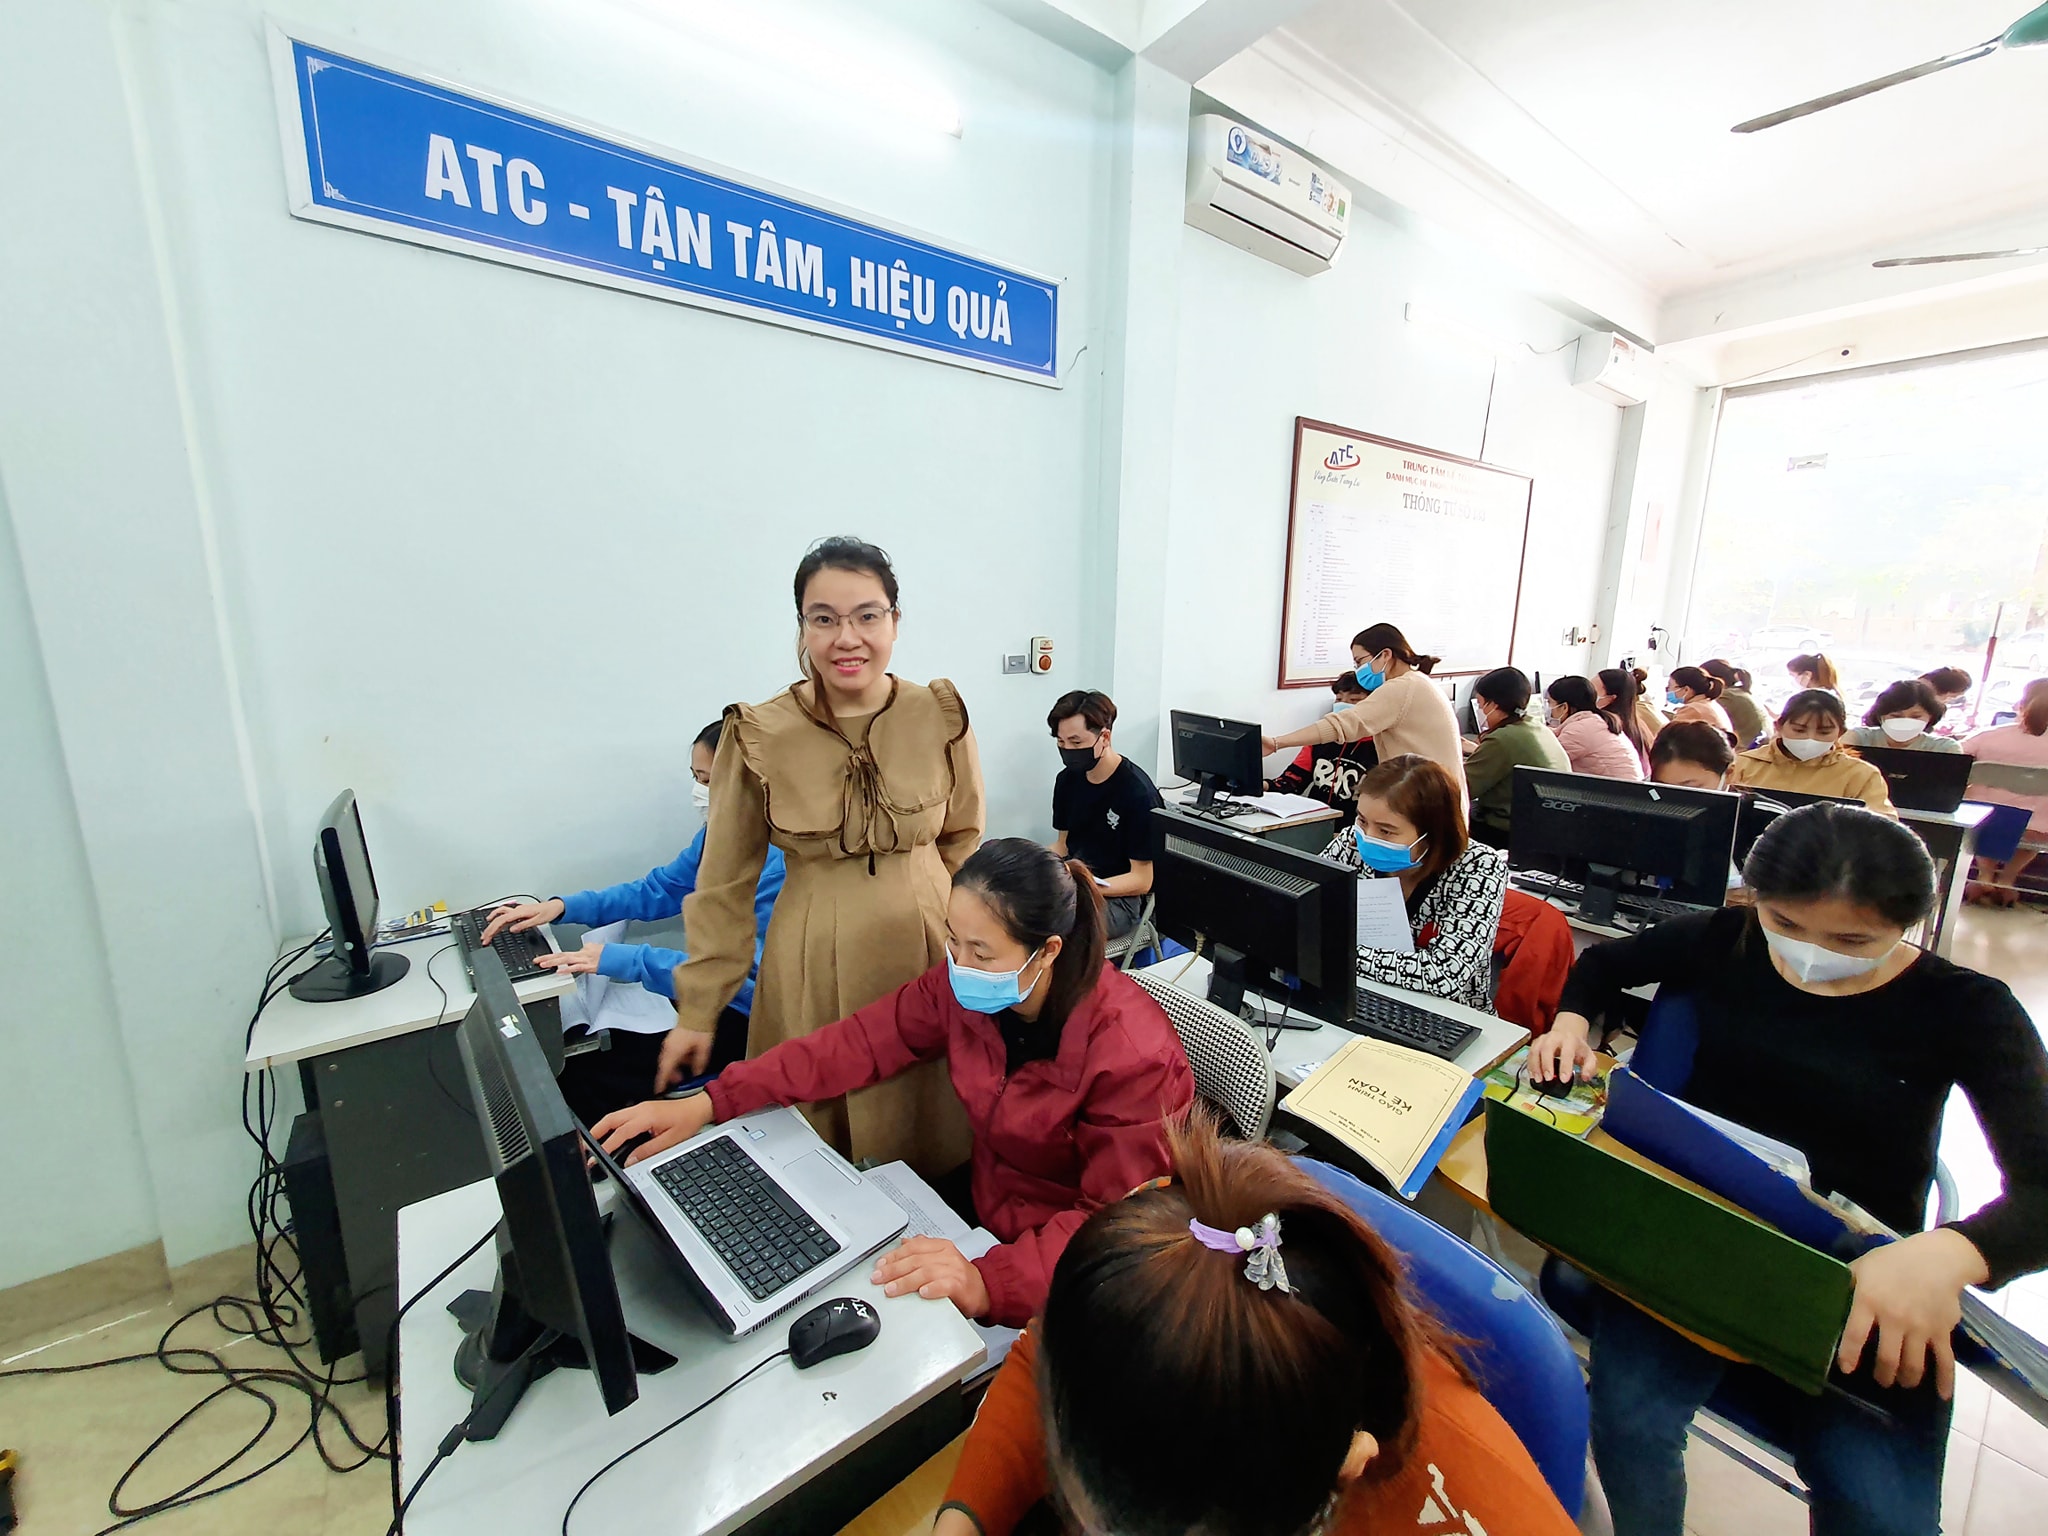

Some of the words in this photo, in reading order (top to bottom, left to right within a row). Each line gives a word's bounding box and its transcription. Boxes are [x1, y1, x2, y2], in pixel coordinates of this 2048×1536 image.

[424, 133, 547, 226] ATC
[569, 202, 590, 220] -
[607, 185, 712, 271] TẬN
[726, 219, 837, 308] TÂM,
[850, 259, 935, 330] HIỆU
[947, 280, 1013, 346] QUẢ
[1330, 444, 1354, 465] ATC
[1403, 460, 1429, 474] TRUNG
[1403, 491, 1440, 514] THÔNG
[1541, 799, 1582, 812] acer
